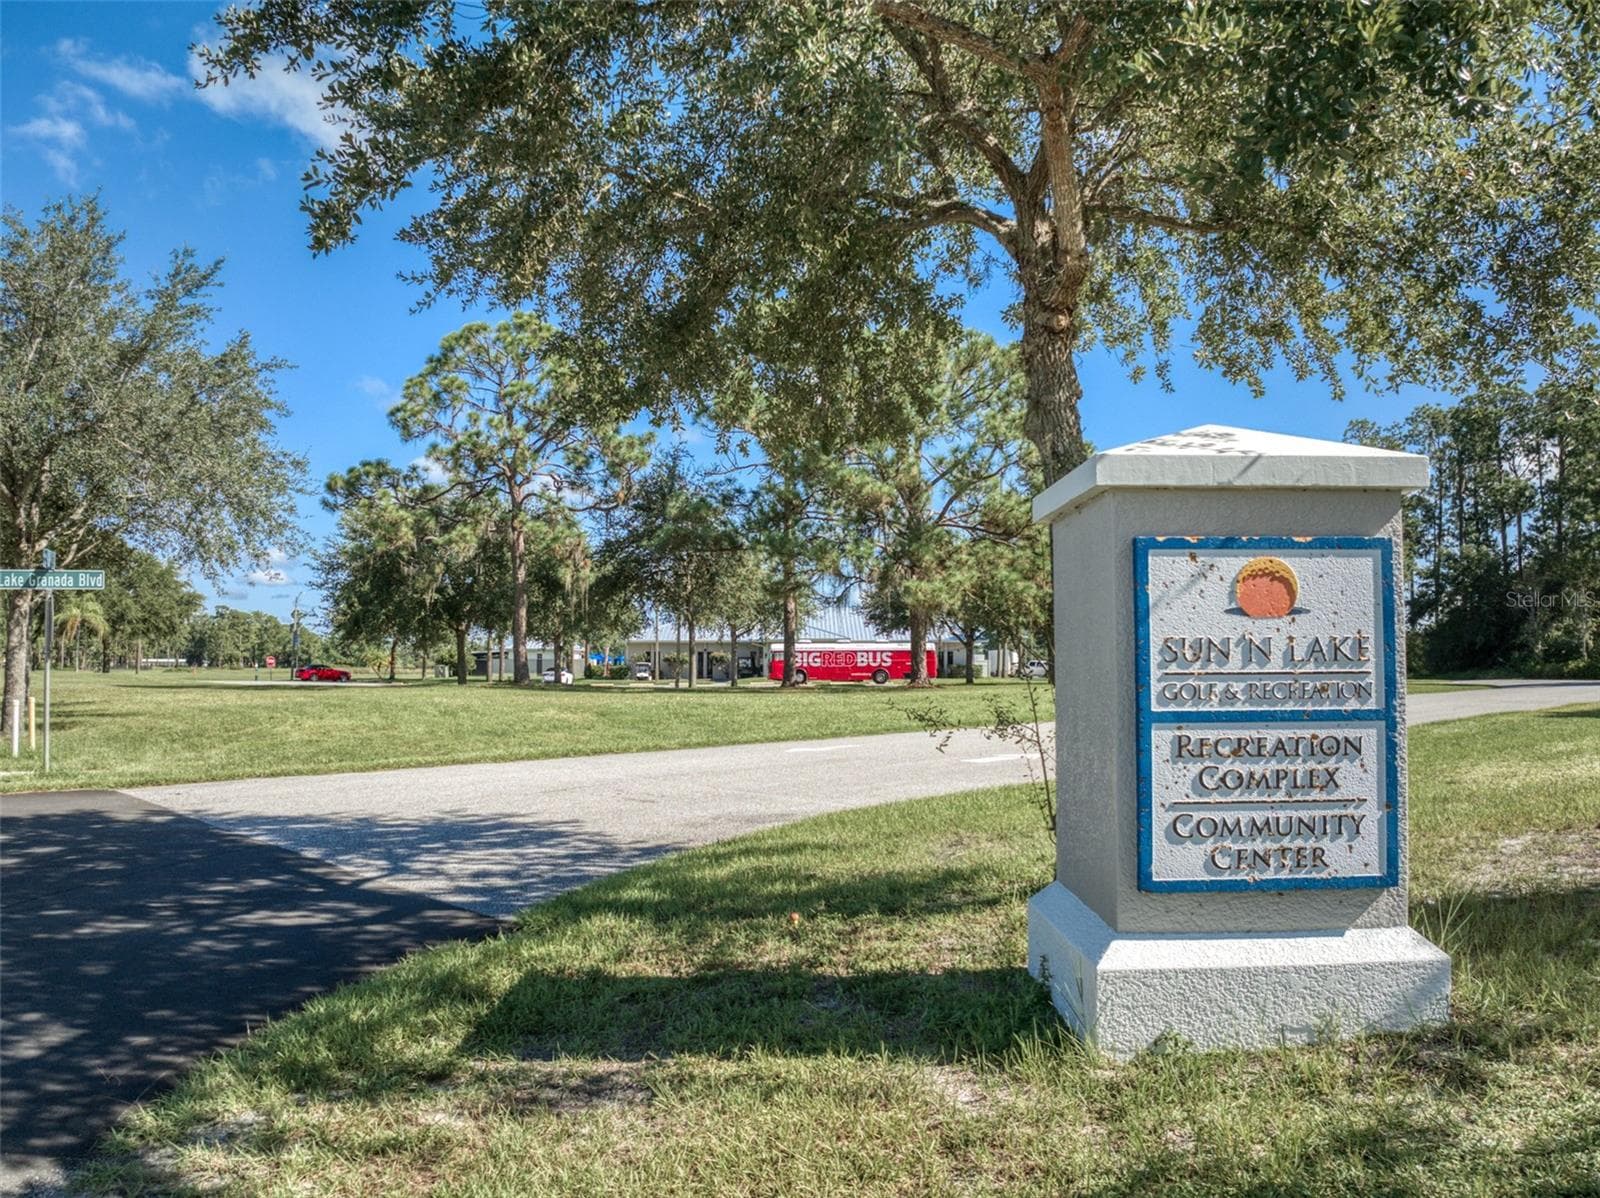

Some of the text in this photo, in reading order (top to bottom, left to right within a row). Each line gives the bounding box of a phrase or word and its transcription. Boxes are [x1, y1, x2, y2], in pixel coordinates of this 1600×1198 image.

[29, 573, 73, 587] Granada
[79, 573, 103, 587] Blvd
[1163, 636, 1234, 664] SUN
[1288, 635, 1371, 663] LAKE
[1162, 681, 1373, 701] GOLF & RECREATION
[1175, 734, 1363, 759] RECREATION
[1198, 765, 1341, 791] COMPLEX
[1172, 813, 1367, 839] COMMUNITY
[1210, 845, 1330, 871] CENTER
